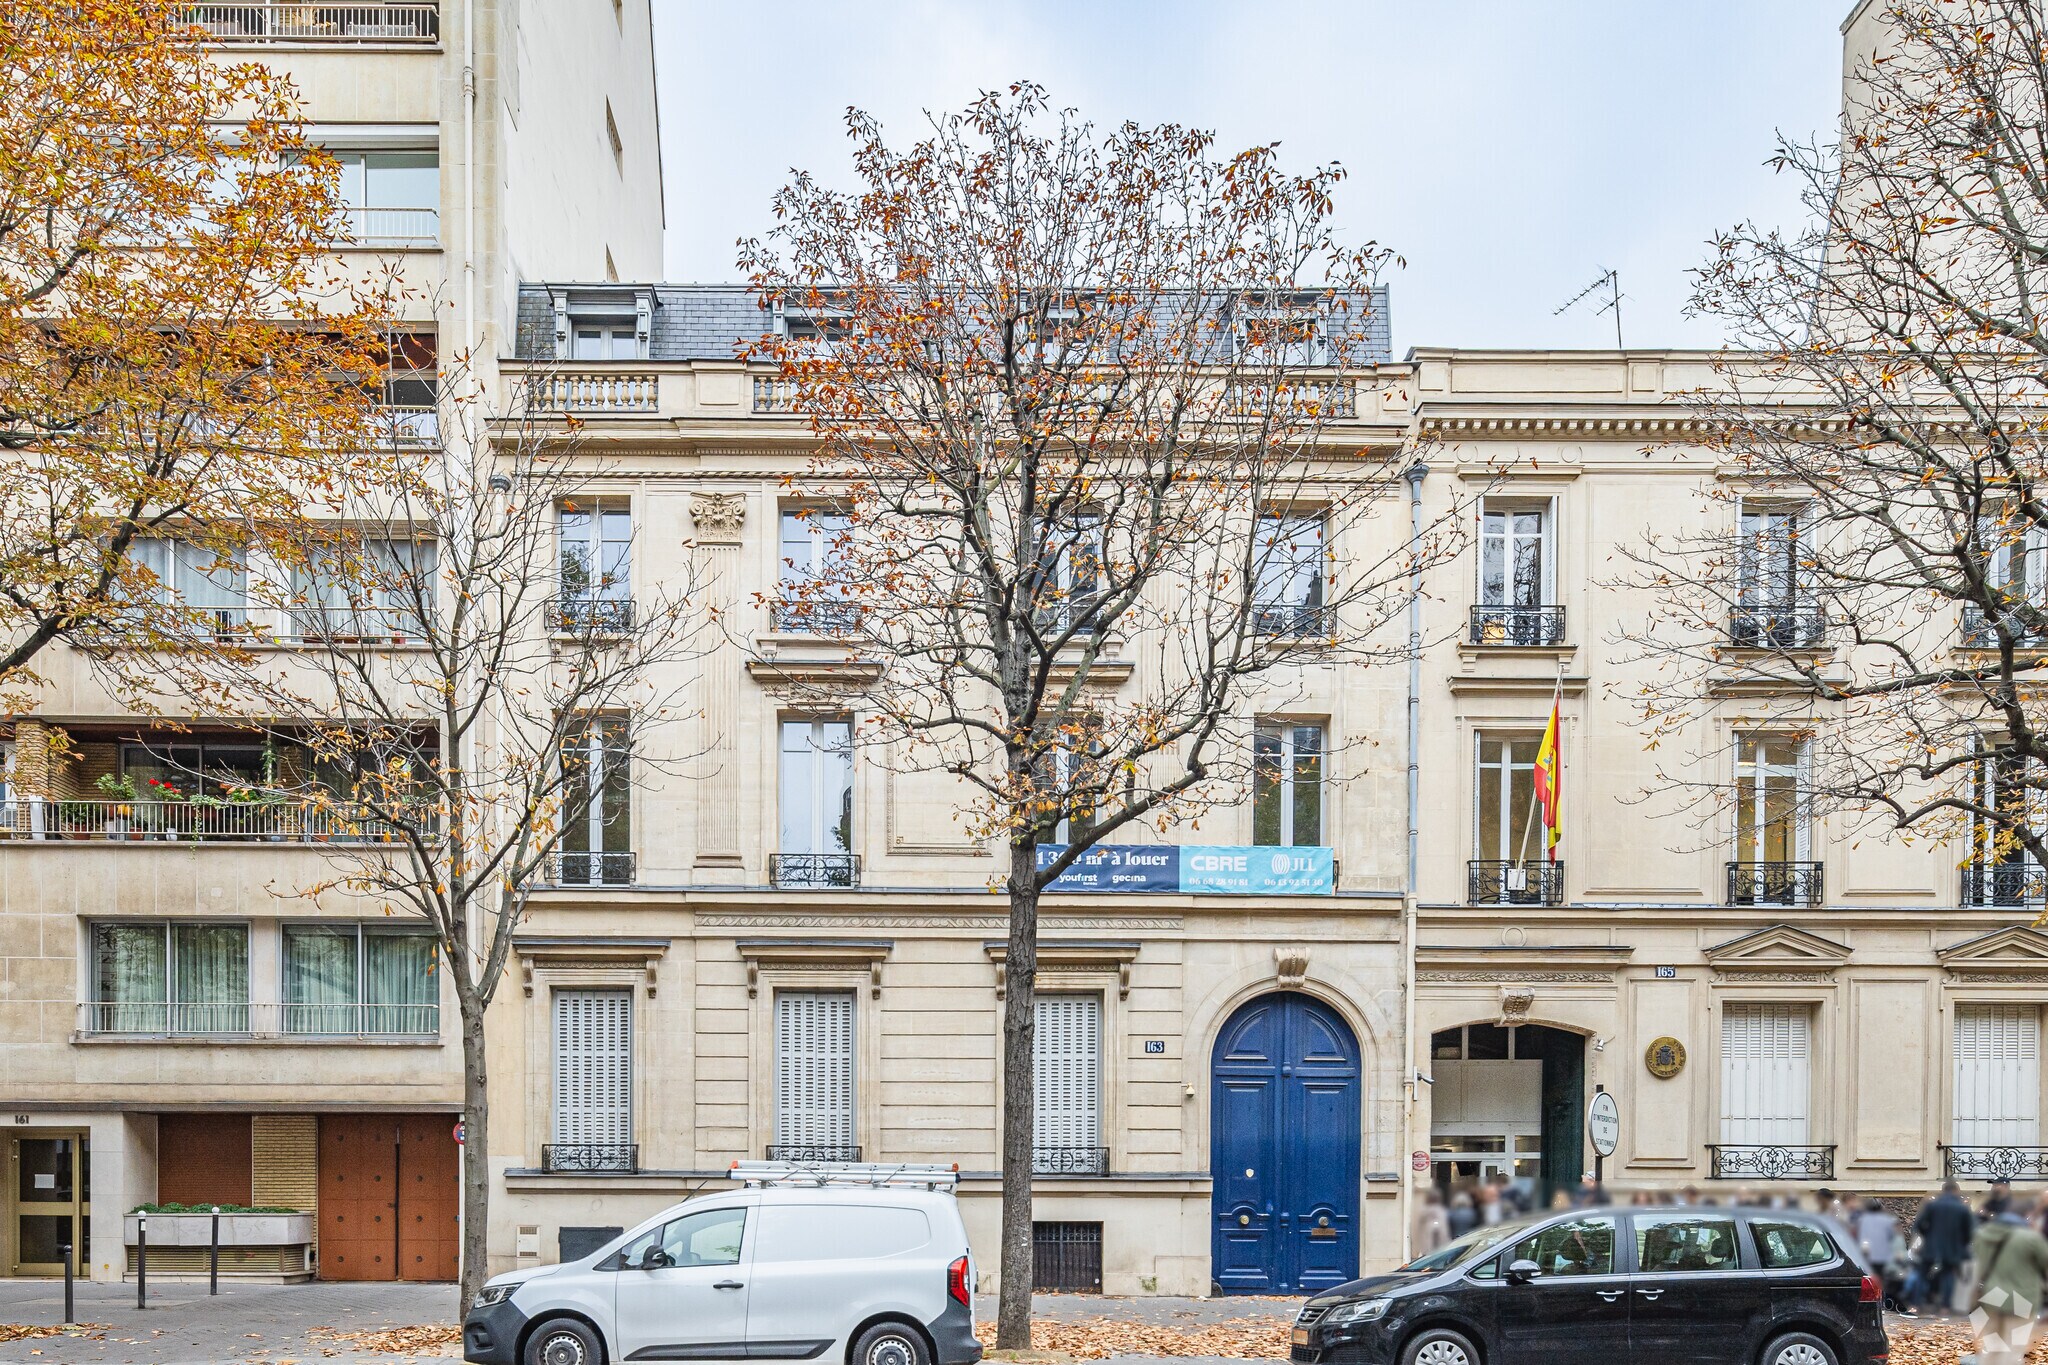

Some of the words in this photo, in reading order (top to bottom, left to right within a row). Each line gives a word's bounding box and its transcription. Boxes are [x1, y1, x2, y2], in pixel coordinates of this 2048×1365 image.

[1111, 851, 1121, 866] à
[1125, 852, 1169, 866] louer
[1190, 855, 1248, 872] CBRE
[1290, 857, 1316, 872] JLL
[1060, 873, 1098, 883] youfirst
[1112, 874, 1147, 883] gecina
[1189, 877, 1201, 885] 06
[1202, 877, 1214, 886] 68
[1228, 878, 1237, 886] 91
[1238, 878, 1248, 886] 81
[1264, 878, 1276, 886] 06
[1289, 879, 1299, 887] 92
[1300, 879, 1310, 887] 51
[1312, 879, 1324, 887] 30
[1657, 966, 1674, 977] 165
[1146, 1041, 1163, 1052] 163
[15, 1115, 30, 1124] 161
[1603, 1126, 1608, 1134] DE
